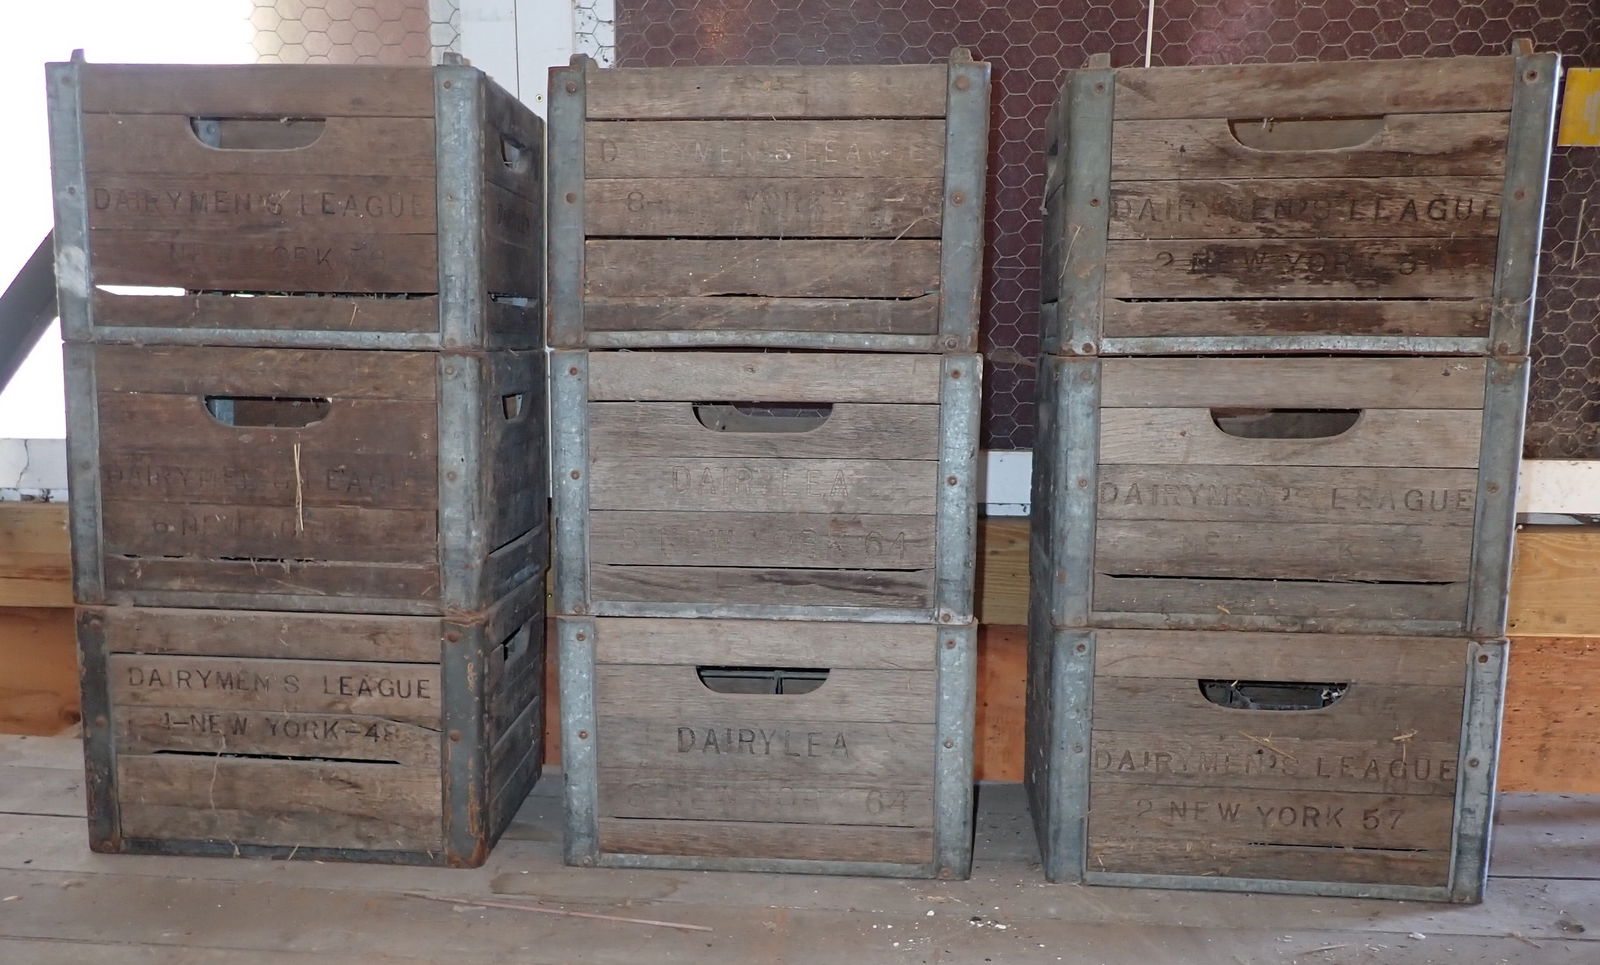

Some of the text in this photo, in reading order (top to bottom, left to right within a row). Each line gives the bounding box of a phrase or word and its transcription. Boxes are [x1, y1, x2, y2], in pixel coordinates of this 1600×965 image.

[299, 192, 428, 219] LEAGUE
[322, 675, 431, 700] LEAGUE
[676, 726, 846, 759] DAIRYLEA
[1315, 757, 1457, 783] LEAGUE
[1167, 800, 1240, 825] NEW
[1255, 805, 1344, 830] YORK
[1361, 807, 1405, 832] 57
